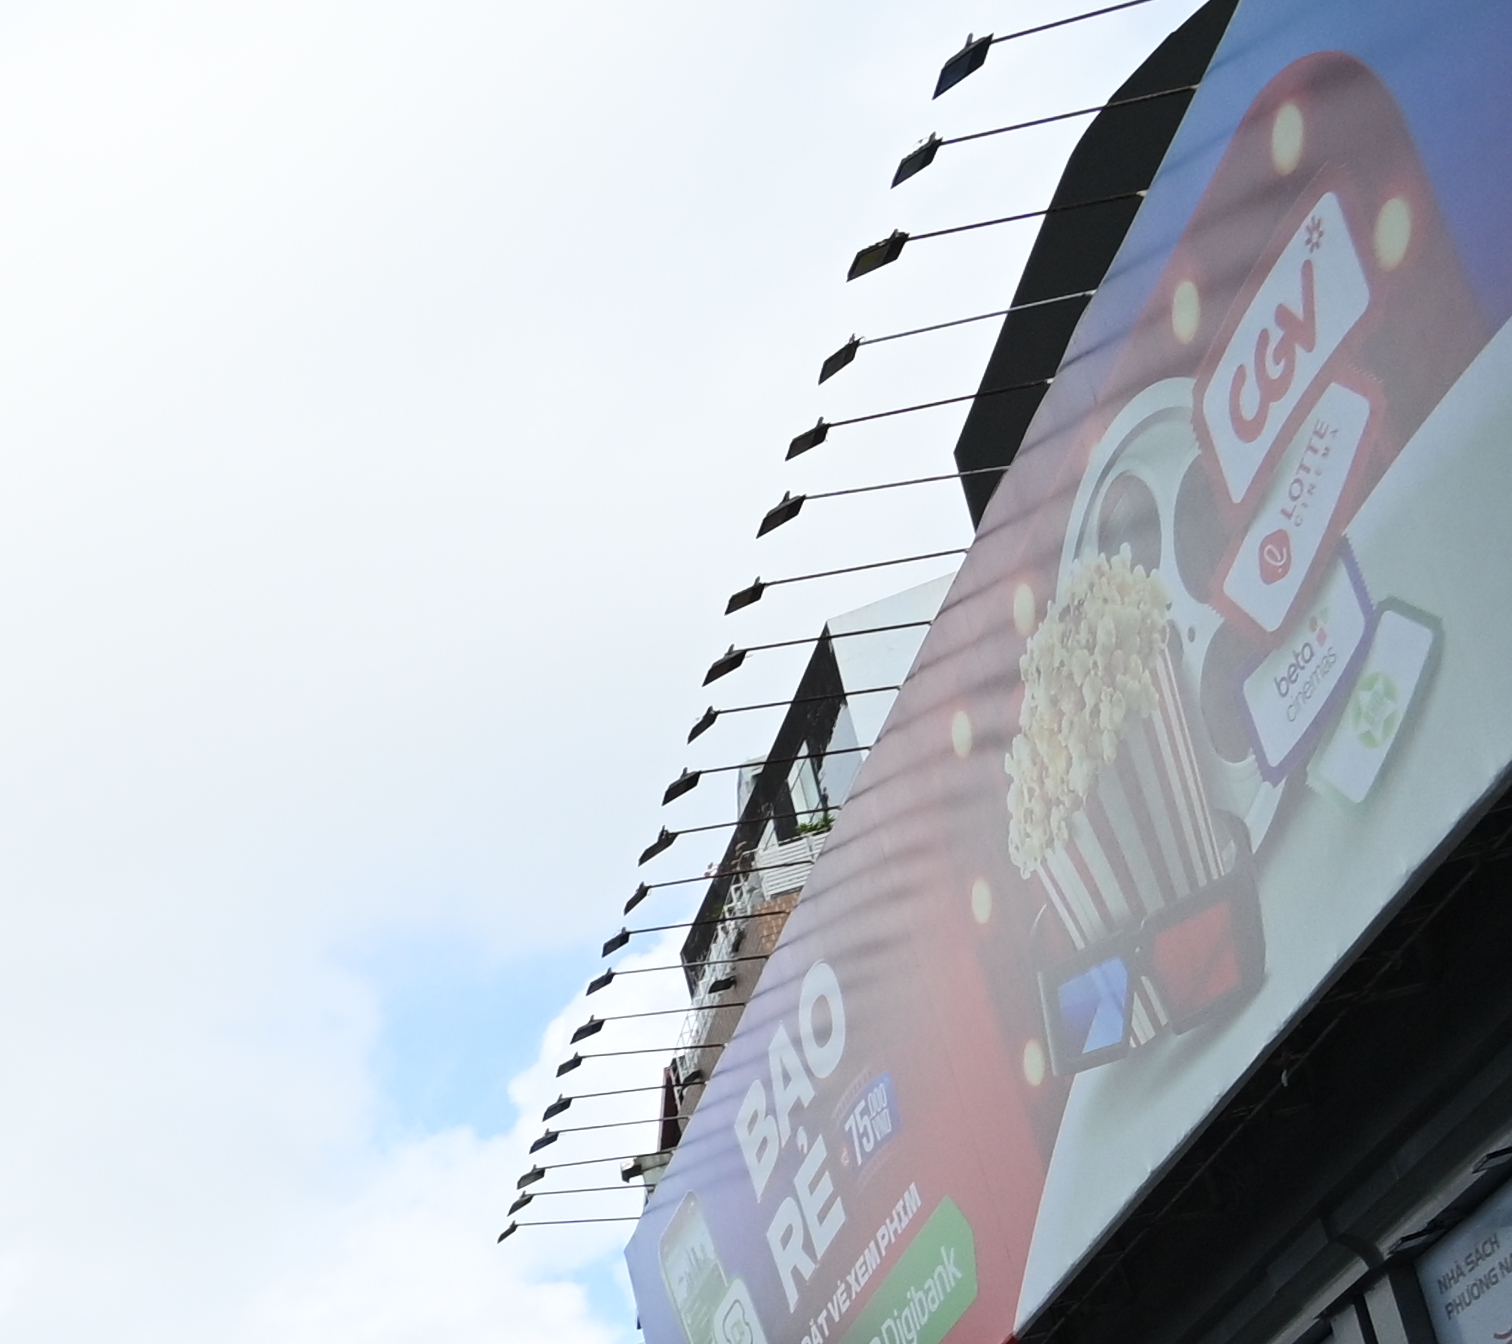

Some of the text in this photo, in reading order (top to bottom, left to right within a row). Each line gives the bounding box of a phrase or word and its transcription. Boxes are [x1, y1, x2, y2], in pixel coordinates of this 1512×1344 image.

[1228, 259, 1317, 444] CGV
[1280, 418, 1329, 526] LOTTE
[1271, 641, 1315, 703] beta
[1284, 643, 1337, 723] cinemas
[827, 1282, 850, 1323] VÉ
[846, 1241, 880, 1293] XEM
[877, 1182, 922, 1257] PHIM
